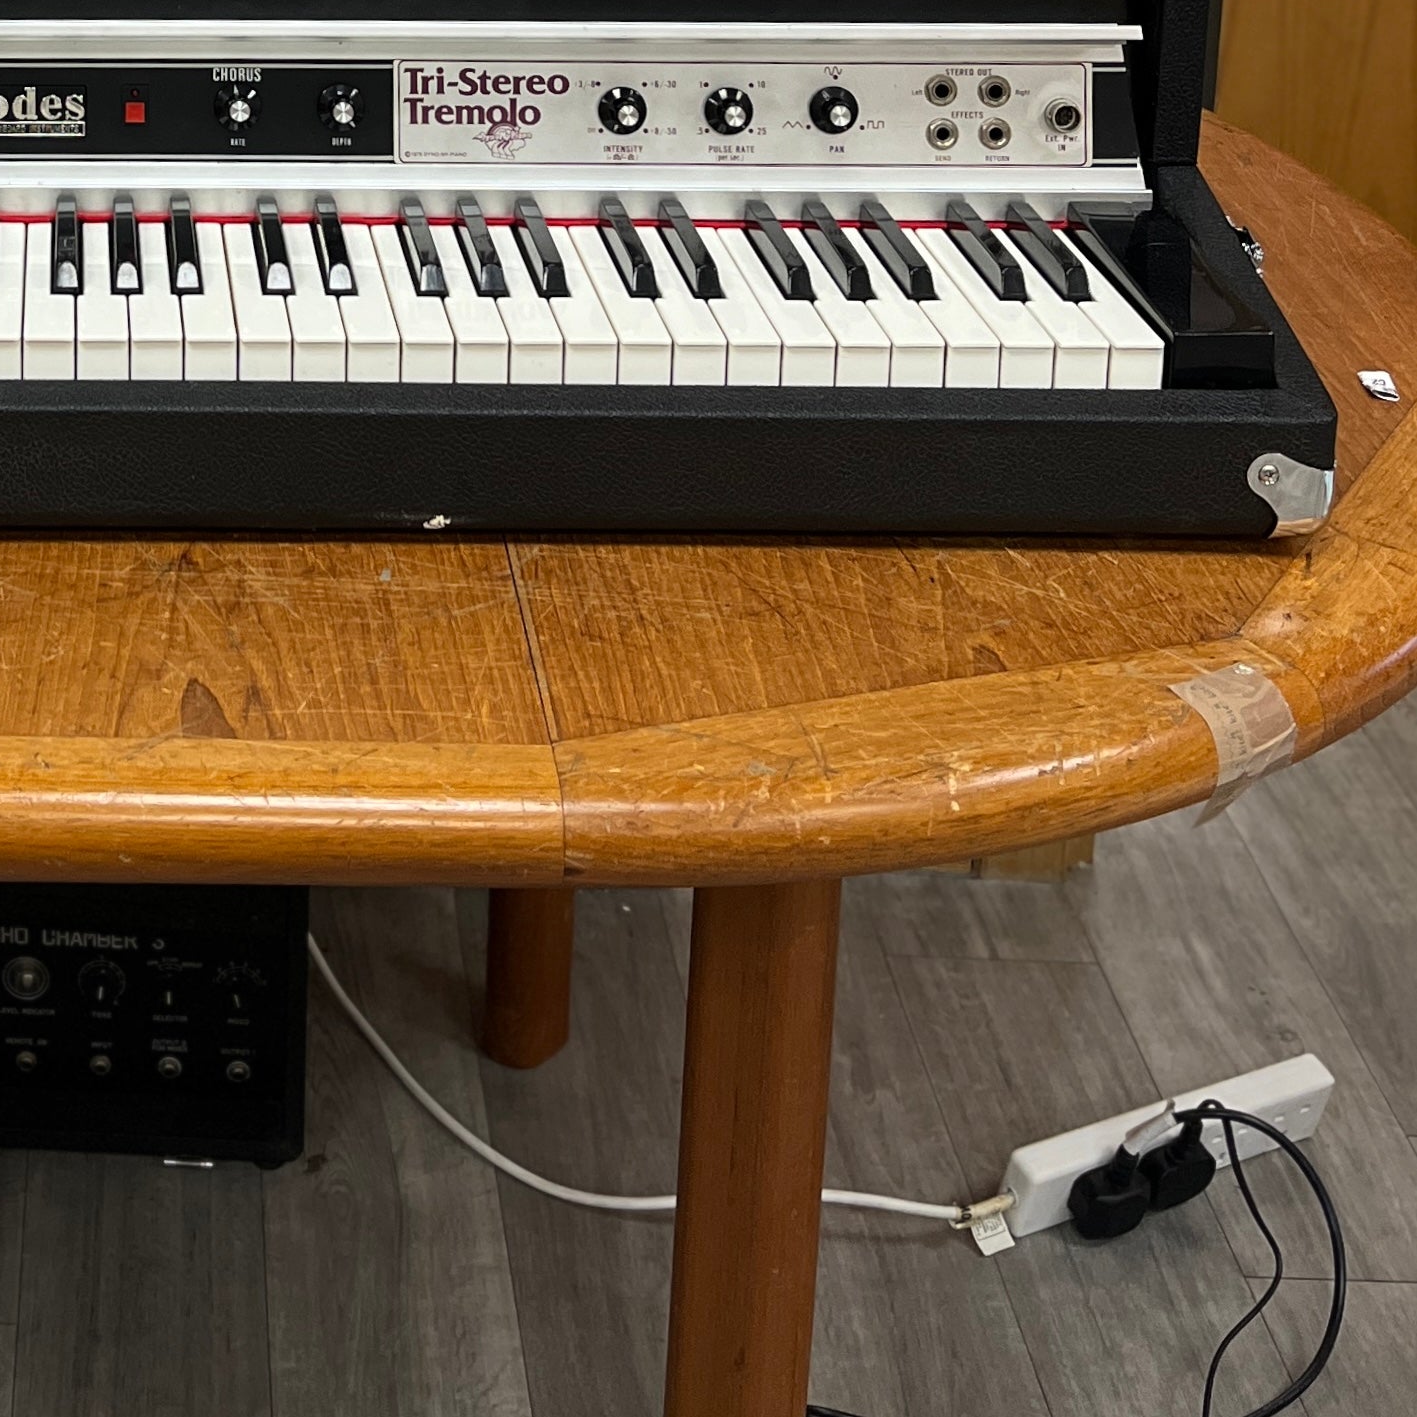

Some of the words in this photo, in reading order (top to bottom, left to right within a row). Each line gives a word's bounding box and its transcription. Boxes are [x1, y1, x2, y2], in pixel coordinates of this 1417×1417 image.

[213, 67, 262, 82] CHORUS
[945, 68, 974, 76] STEREO
[977, 68, 992, 76] OUT
[403, 66, 570, 96] Tri-Stereo
[403, 97, 541, 126] Tremolo
[951, 111, 984, 119] EFFECTS
[604, 145, 643, 153] INTENSITY
[708, 145, 732, 153] PULSE
[735, 145, 755, 153] RATE
[829, 145, 845, 153] PAN
[1057, 144, 1066, 152] IN
